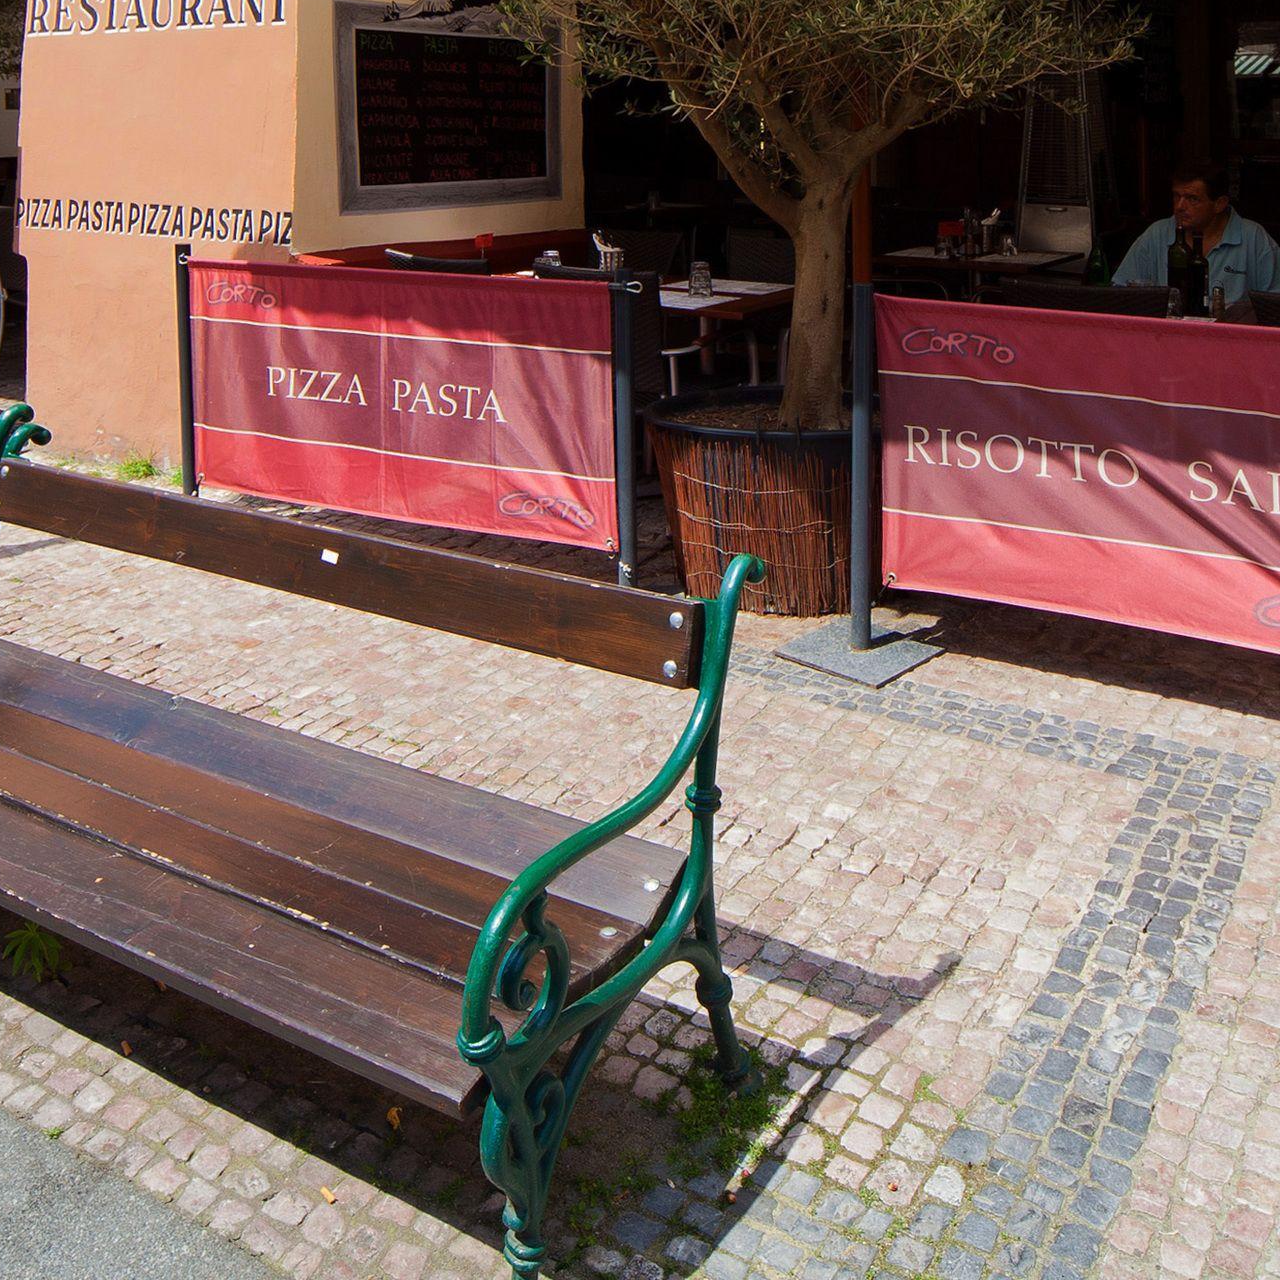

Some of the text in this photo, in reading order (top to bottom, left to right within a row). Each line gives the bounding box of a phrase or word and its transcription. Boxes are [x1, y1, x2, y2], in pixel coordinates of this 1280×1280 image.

[16, 198, 64, 231] PIZZA
[66, 199, 126, 235] PASTA
[127, 202, 186, 238] PIZZA
[188, 206, 255, 245] PASTA
[205, 279, 279, 311] CORTO
[899, 326, 1019, 366] CORTO
[266, 365, 508, 424] PIZZA PASTA
[902, 424, 1141, 490] RISOTTO
